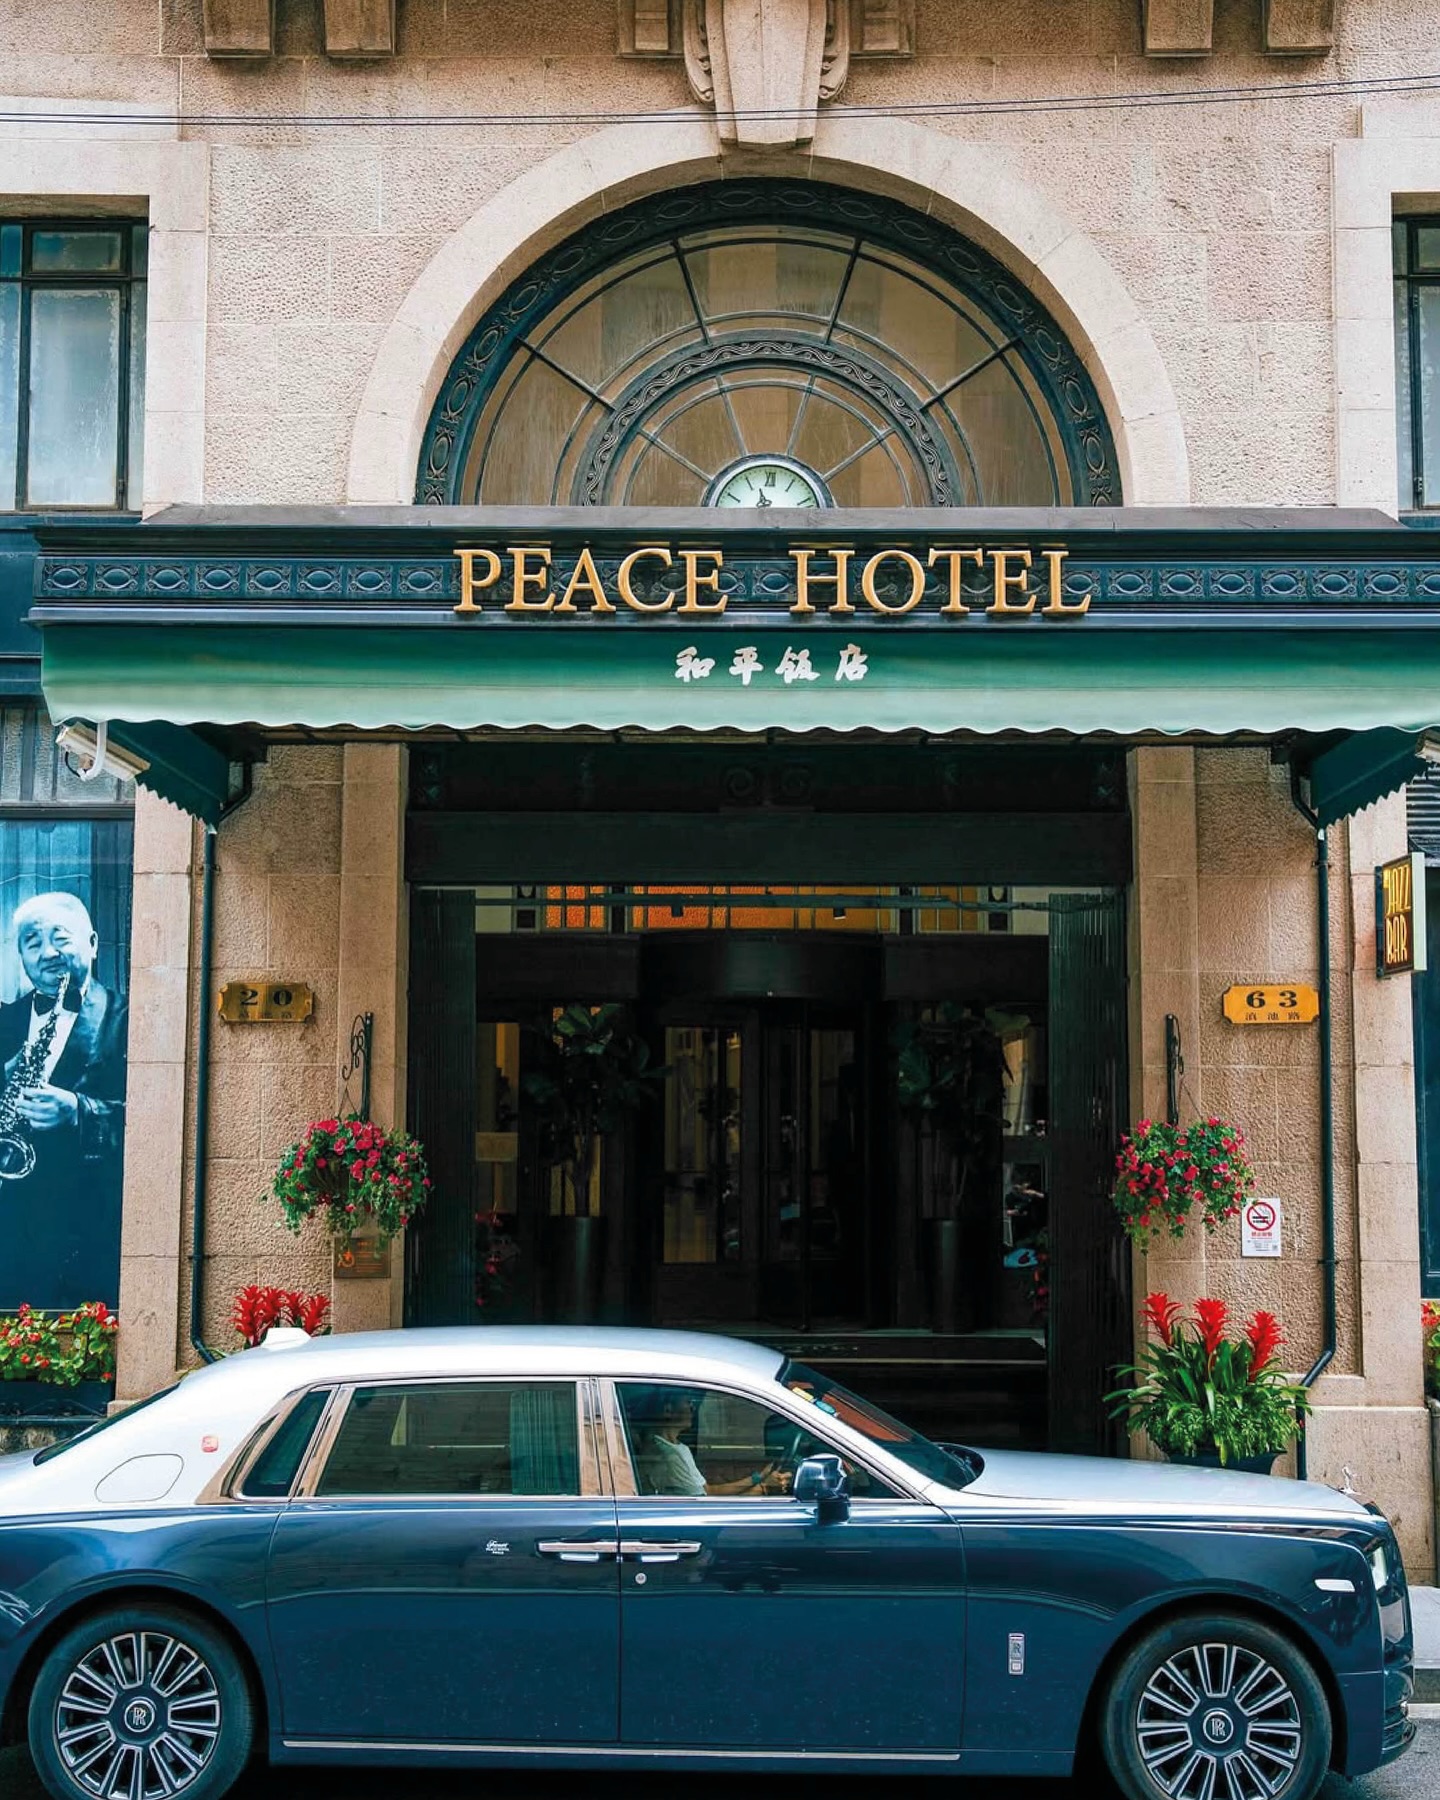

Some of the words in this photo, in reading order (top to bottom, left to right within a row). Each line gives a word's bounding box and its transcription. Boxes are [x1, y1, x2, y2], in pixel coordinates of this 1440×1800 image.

[453, 547, 728, 612] PEACE
[788, 548, 1092, 612] HOTEL
[674, 643, 870, 686] 和平饭店
[1384, 865, 1411, 914] JAZZ
[1386, 914, 1408, 964] BAR
